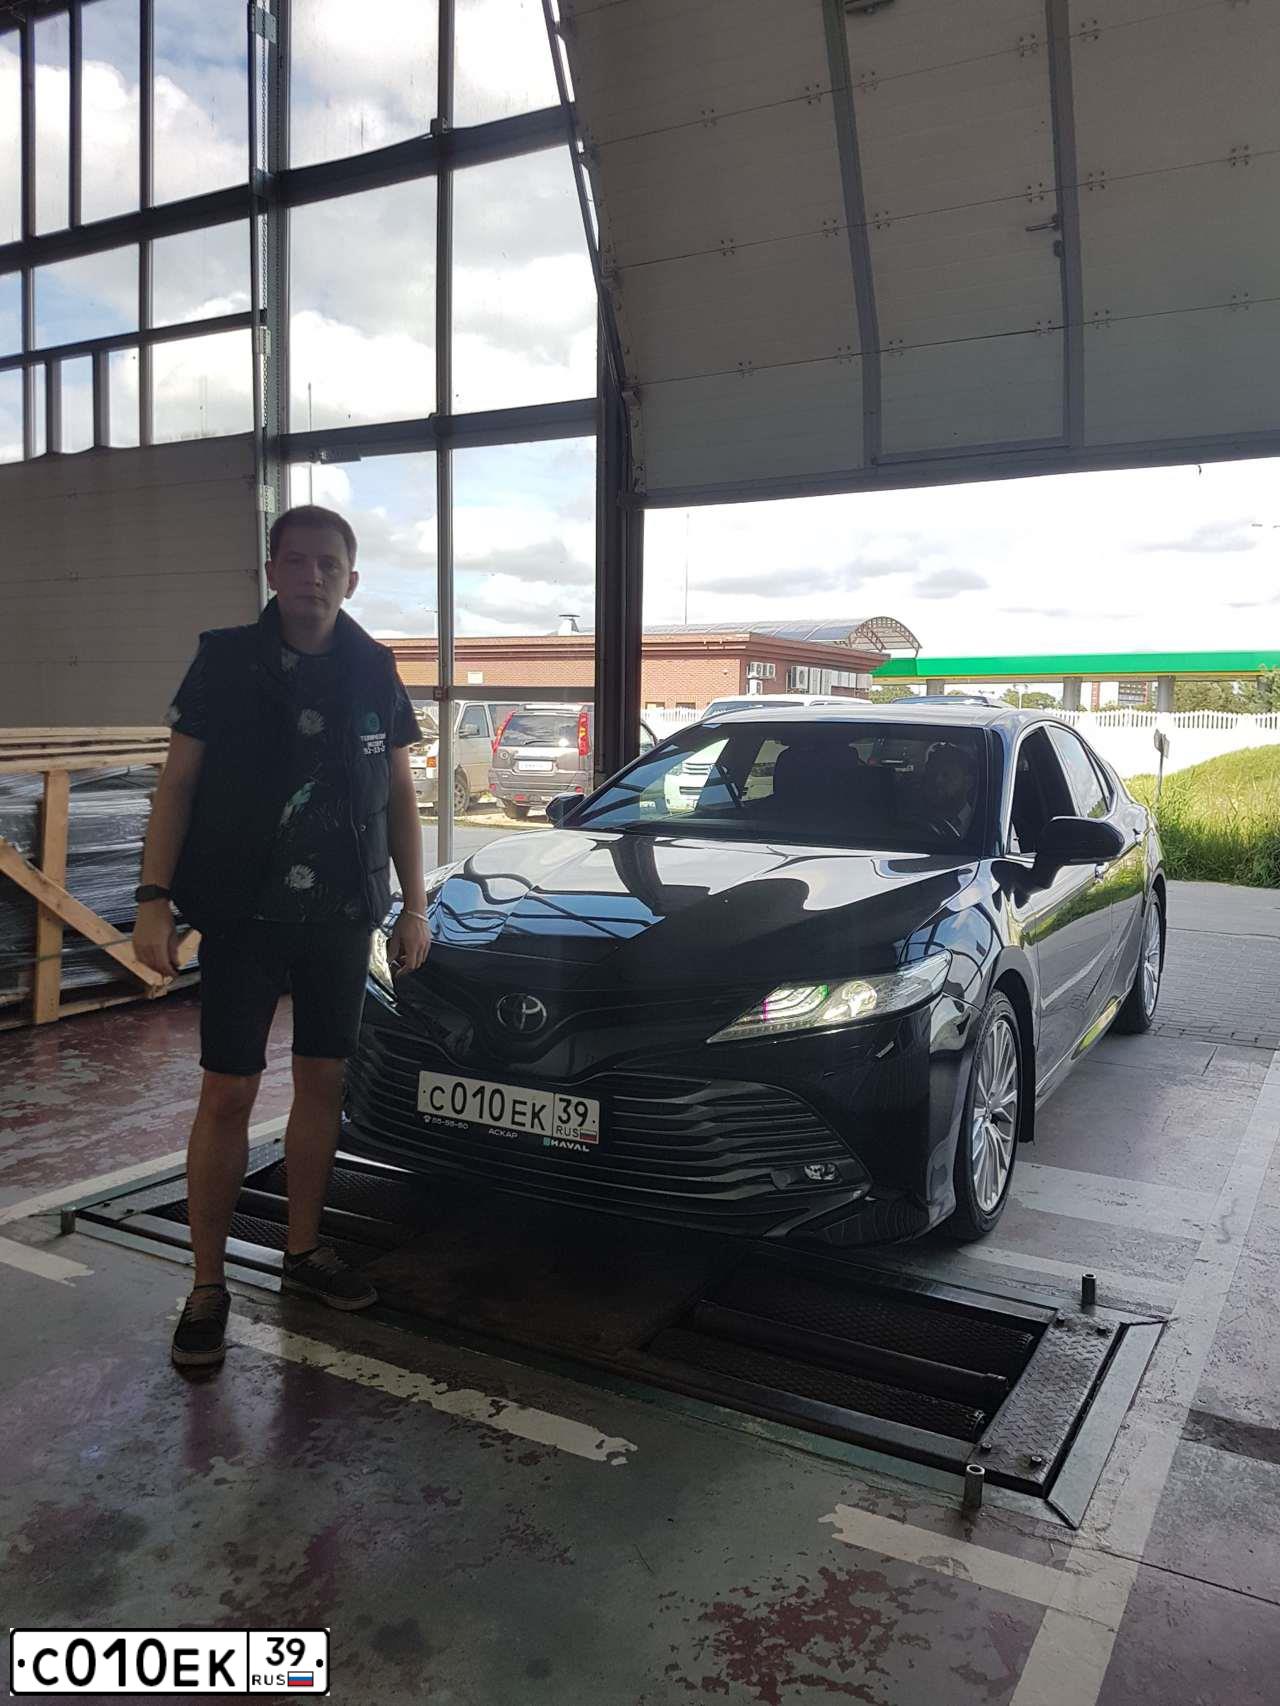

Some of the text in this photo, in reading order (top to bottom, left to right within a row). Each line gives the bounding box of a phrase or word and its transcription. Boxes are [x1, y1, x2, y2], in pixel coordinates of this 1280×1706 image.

[430, 1082, 588, 1131] С010ЕК 39
[556, 1126, 579, 1138] RUS
[551, 1139, 590, 1152] HAVAL
